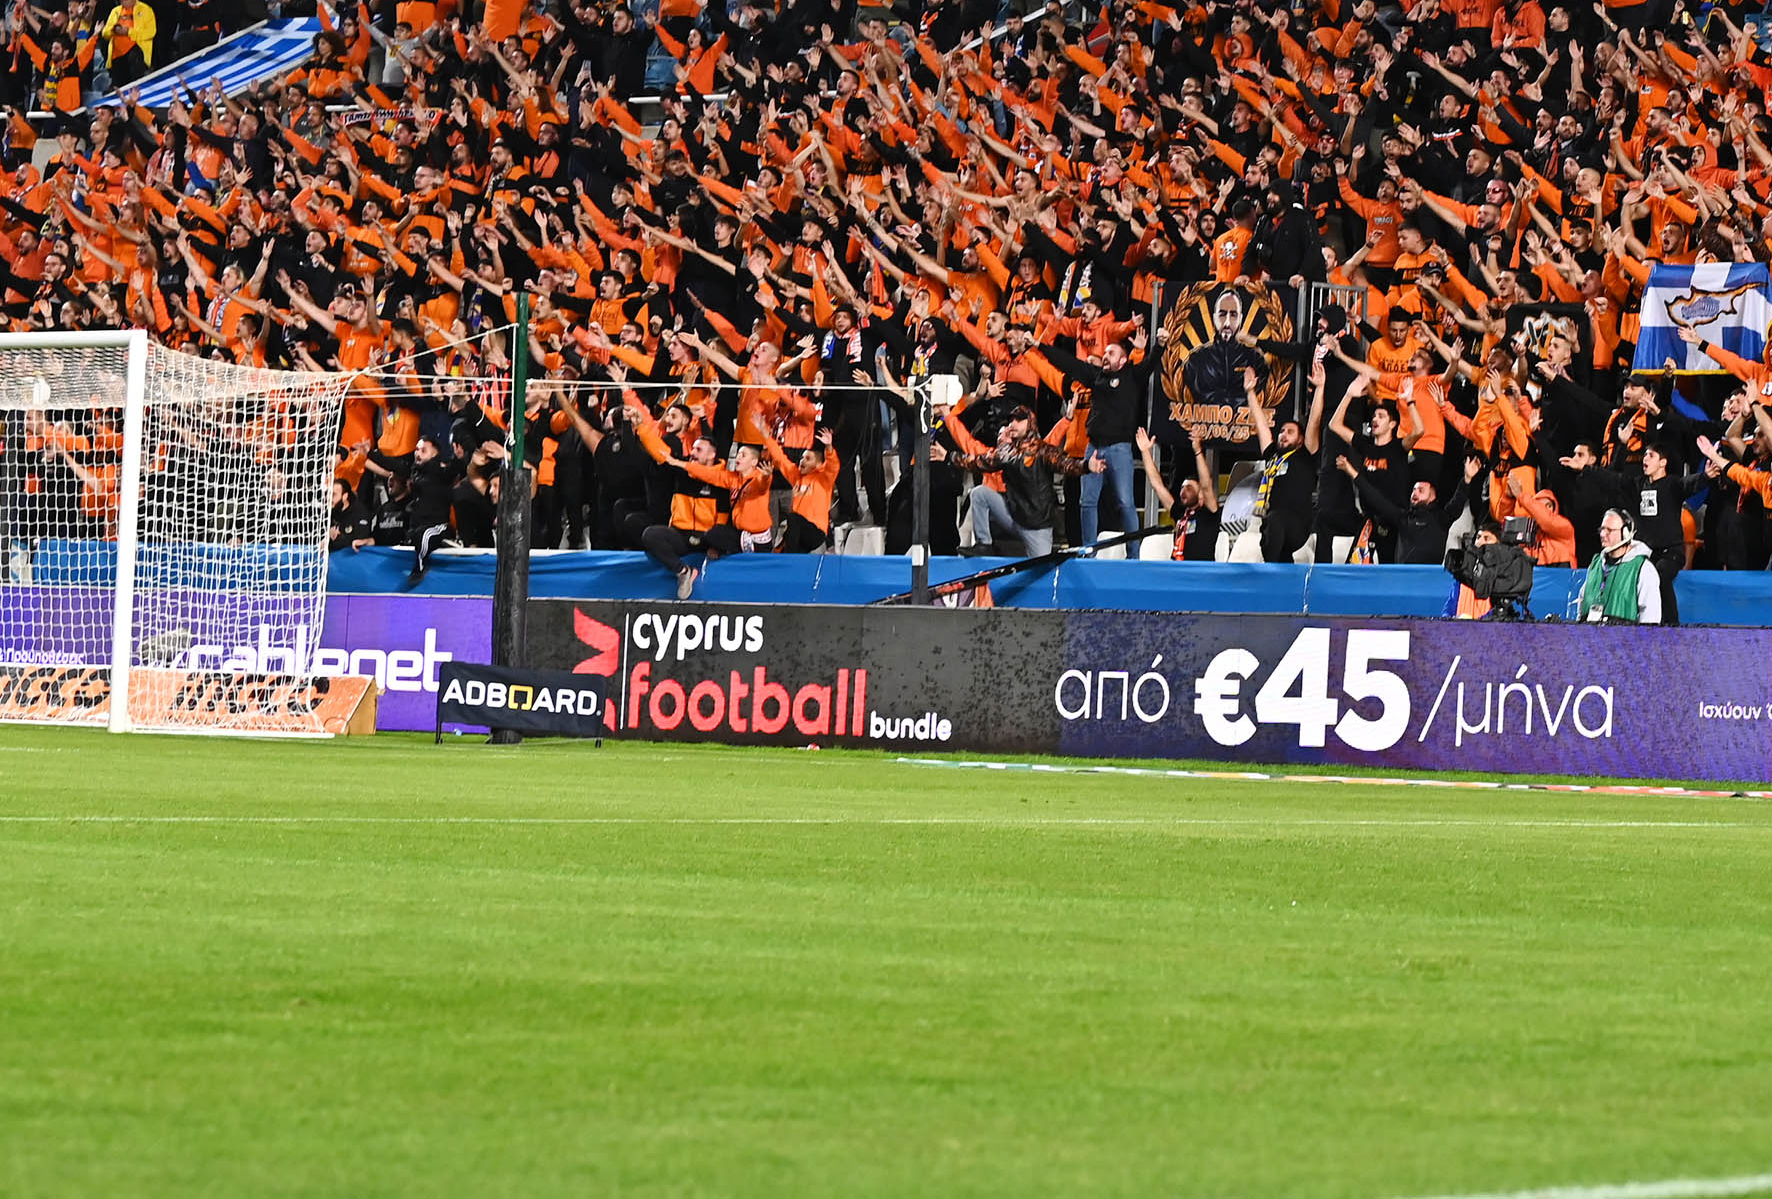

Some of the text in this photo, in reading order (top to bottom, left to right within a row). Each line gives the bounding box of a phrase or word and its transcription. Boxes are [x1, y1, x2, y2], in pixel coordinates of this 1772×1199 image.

[1168, 401, 1276, 428] ΧΑΜΠΟ ΖΣ
[632, 612, 764, 662] cyprus
[627, 660, 867, 737] football
[1054, 653, 1172, 721] από
[1194, 626, 1412, 752] €45
[869, 710, 952, 741] bundle
[1698, 700, 1762, 722] Ισχύουν
